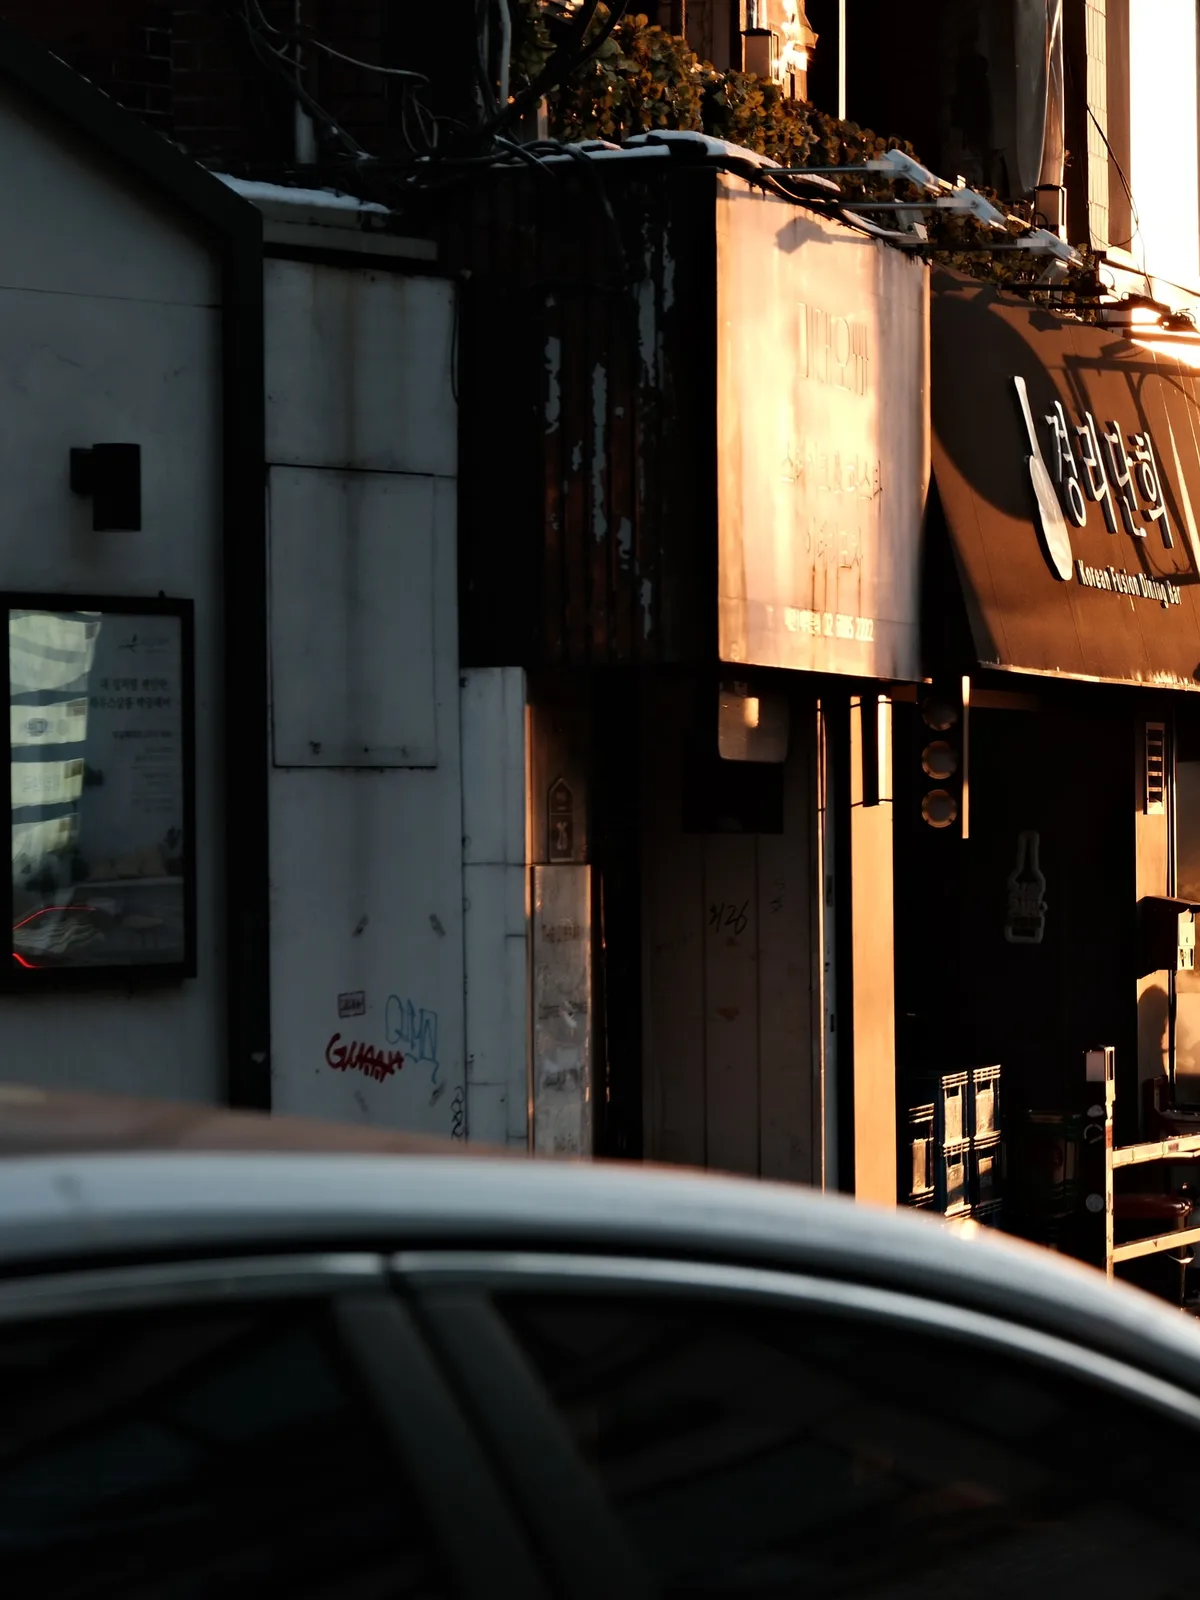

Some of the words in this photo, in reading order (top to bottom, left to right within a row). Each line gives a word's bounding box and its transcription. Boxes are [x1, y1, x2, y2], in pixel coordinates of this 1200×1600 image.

[1044, 400, 1174, 549] 경리단희
[1077, 559, 1111, 589] Korean
[1108, 565, 1138, 597] Fusion
[1138, 572, 1168, 608] Dining
[1166, 580, 1182, 605] Bar
